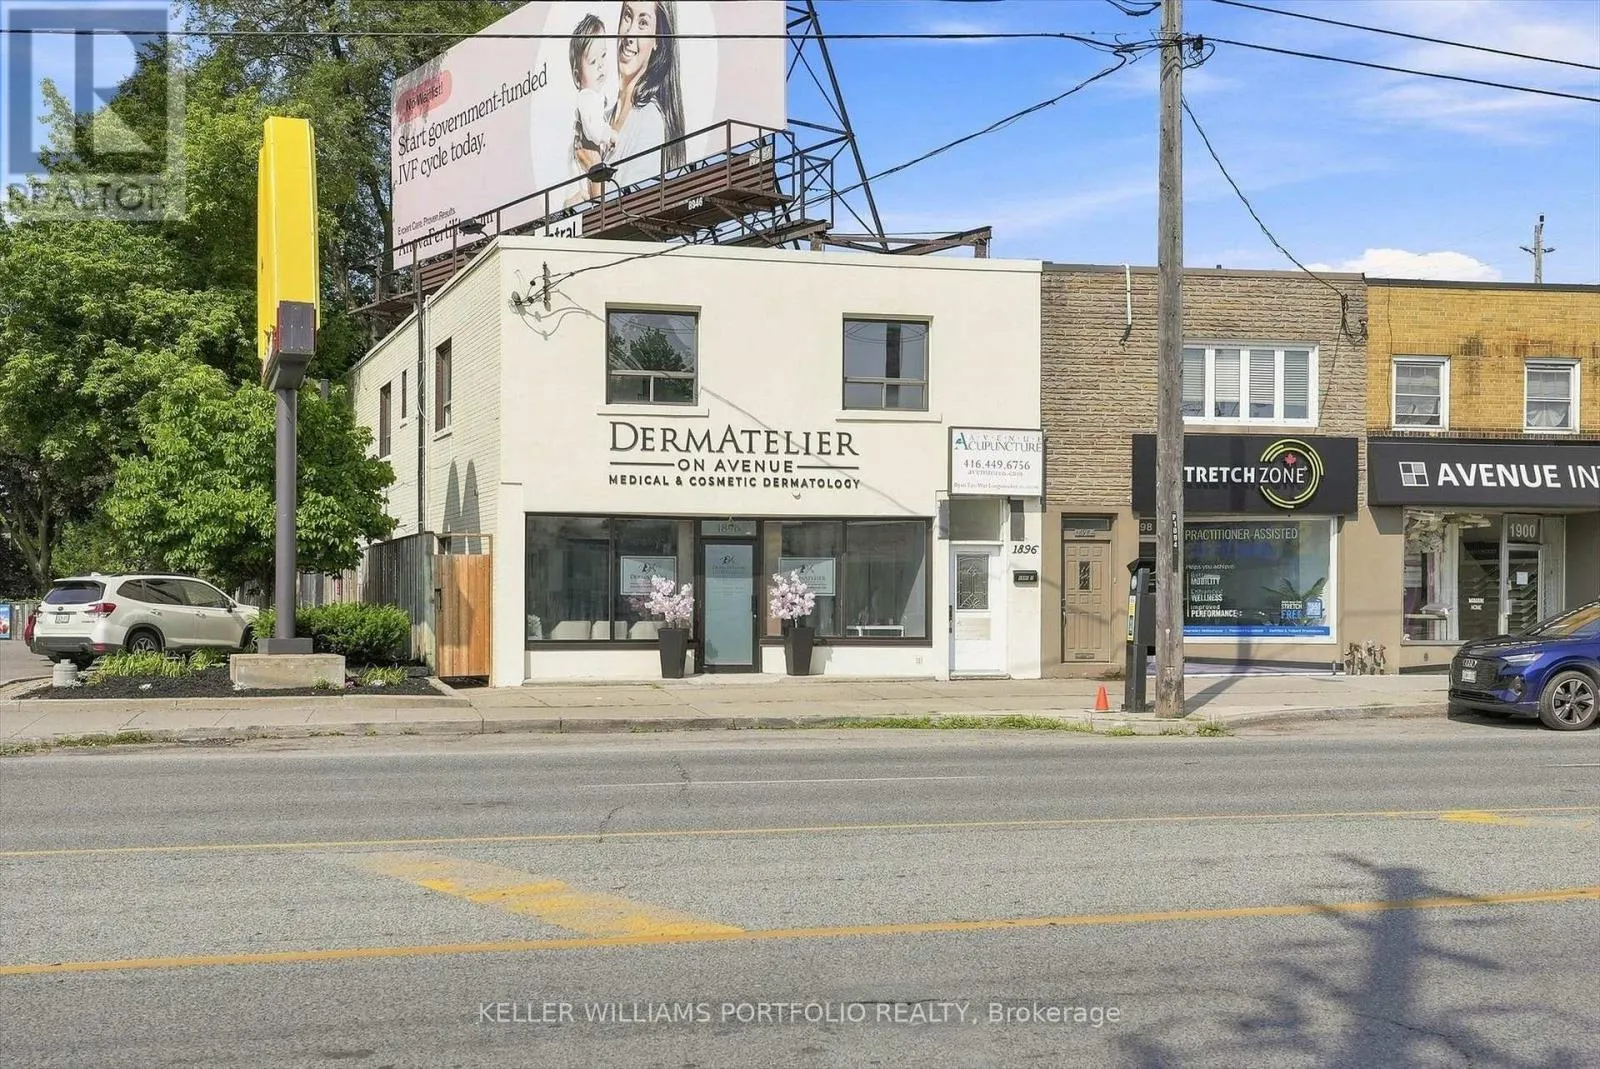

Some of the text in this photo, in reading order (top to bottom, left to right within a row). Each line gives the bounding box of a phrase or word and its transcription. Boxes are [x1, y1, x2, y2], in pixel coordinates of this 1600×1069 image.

[398, 62, 548, 156] Start government-funded
[399, 132, 486, 185] IVF cycle today.
[423, 214, 439, 226] Proven
[677, 458, 794, 474] ON AVENUE
[963, 459, 1031, 470] 416.449.6756
[608, 474, 860, 490] MEDICAL & COSMETIC DERMATOLOGY
[1183, 466, 1305, 483] TRETCH ZONE
[1437, 462, 1600, 488] AVENUE IN
[1254, 528, 1298, 540] ASSISTED
[1509, 523, 1537, 538] 1900
[1012, 544, 1039, 554] 1896
[1191, 594, 1223, 602] WELLNESS
